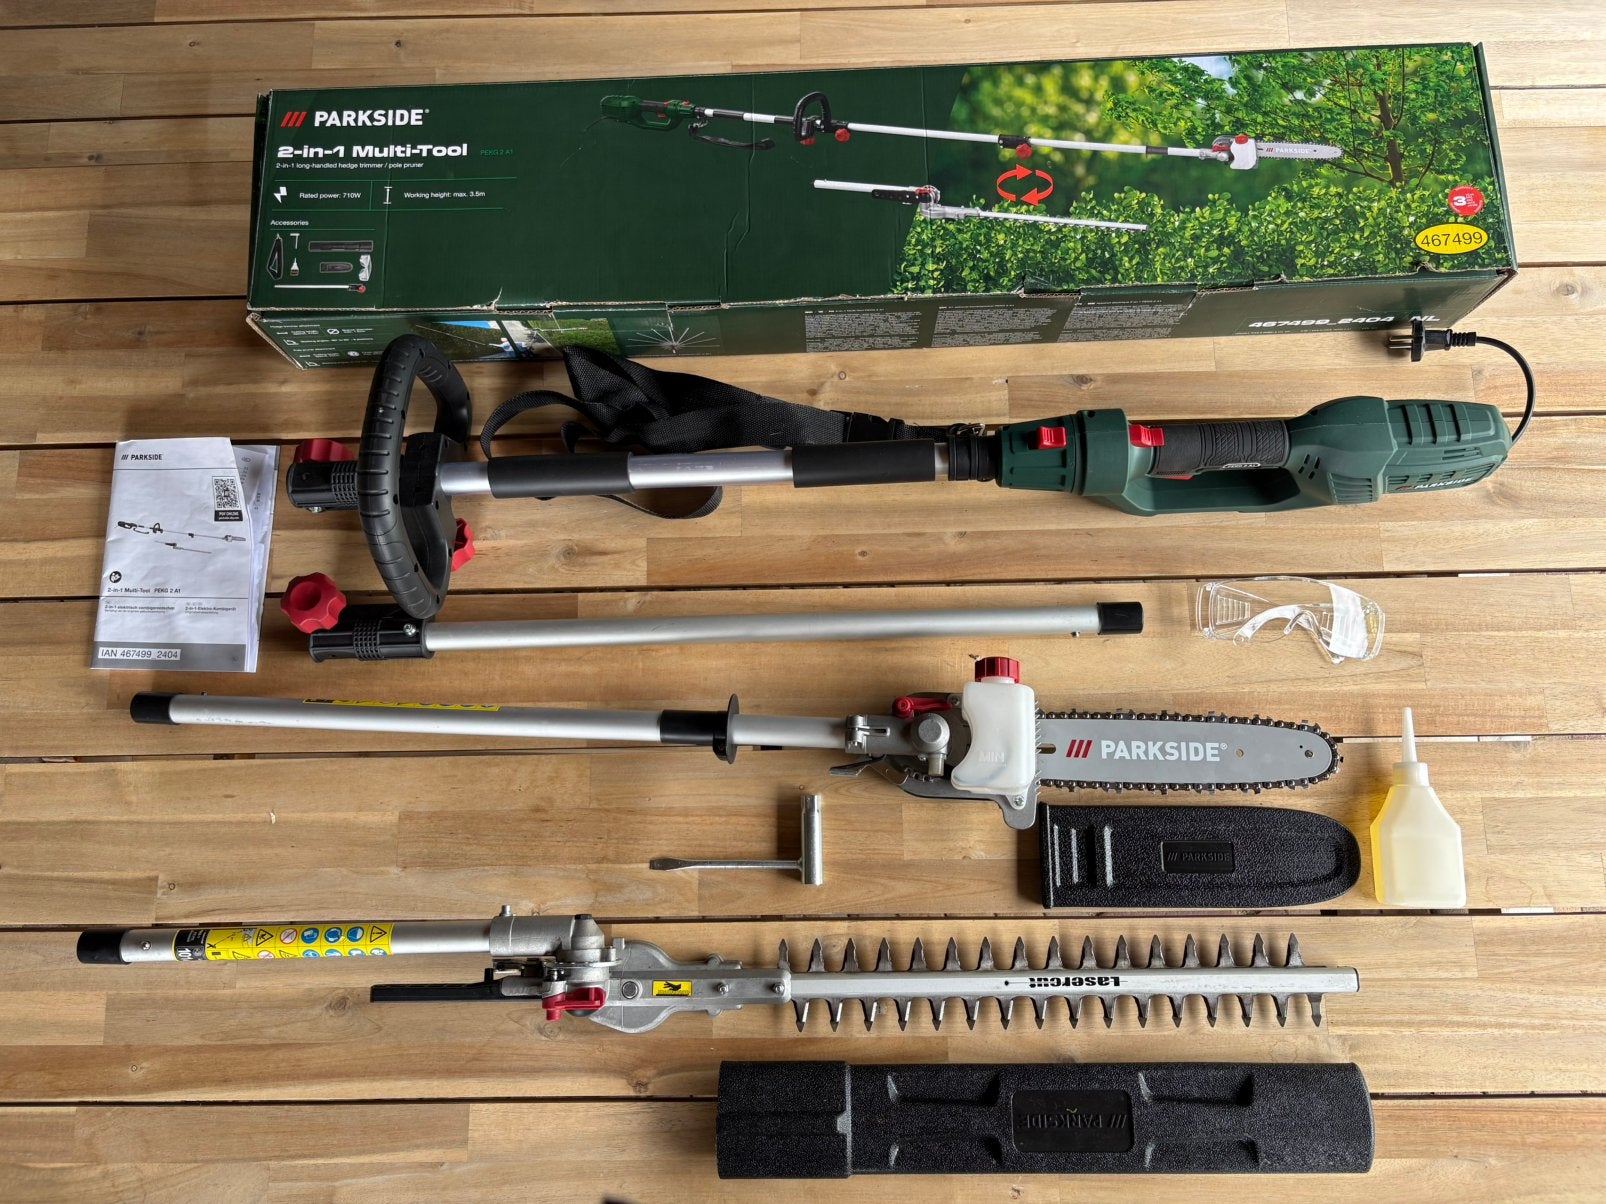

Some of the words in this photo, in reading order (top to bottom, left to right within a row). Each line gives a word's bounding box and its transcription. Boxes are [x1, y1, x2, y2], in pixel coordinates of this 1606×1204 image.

[313, 109, 424, 127] PARKSIDE
[277, 145, 345, 158] 2-in-1
[352, 143, 468, 158] Multi-Tool
[296, 161, 338, 169] long-handled
[338, 161, 359, 169] hedge
[359, 161, 384, 169] trimmer
[388, 161, 403, 169] pole
[430, 191, 451, 199] height:
[1453, 195, 1467, 206] 3
[1420, 230, 1483, 248] 467499
[1249, 316, 1395, 328] 467499_2404
[130, 453, 163, 461] PARKSIDE
[101, 648, 118, 658] IAN
[1101, 740, 1221, 762] PARKSIDE
[1182, 852, 1231, 862] PARKSIDE
[1029, 976, 1121, 988] Lasercut
